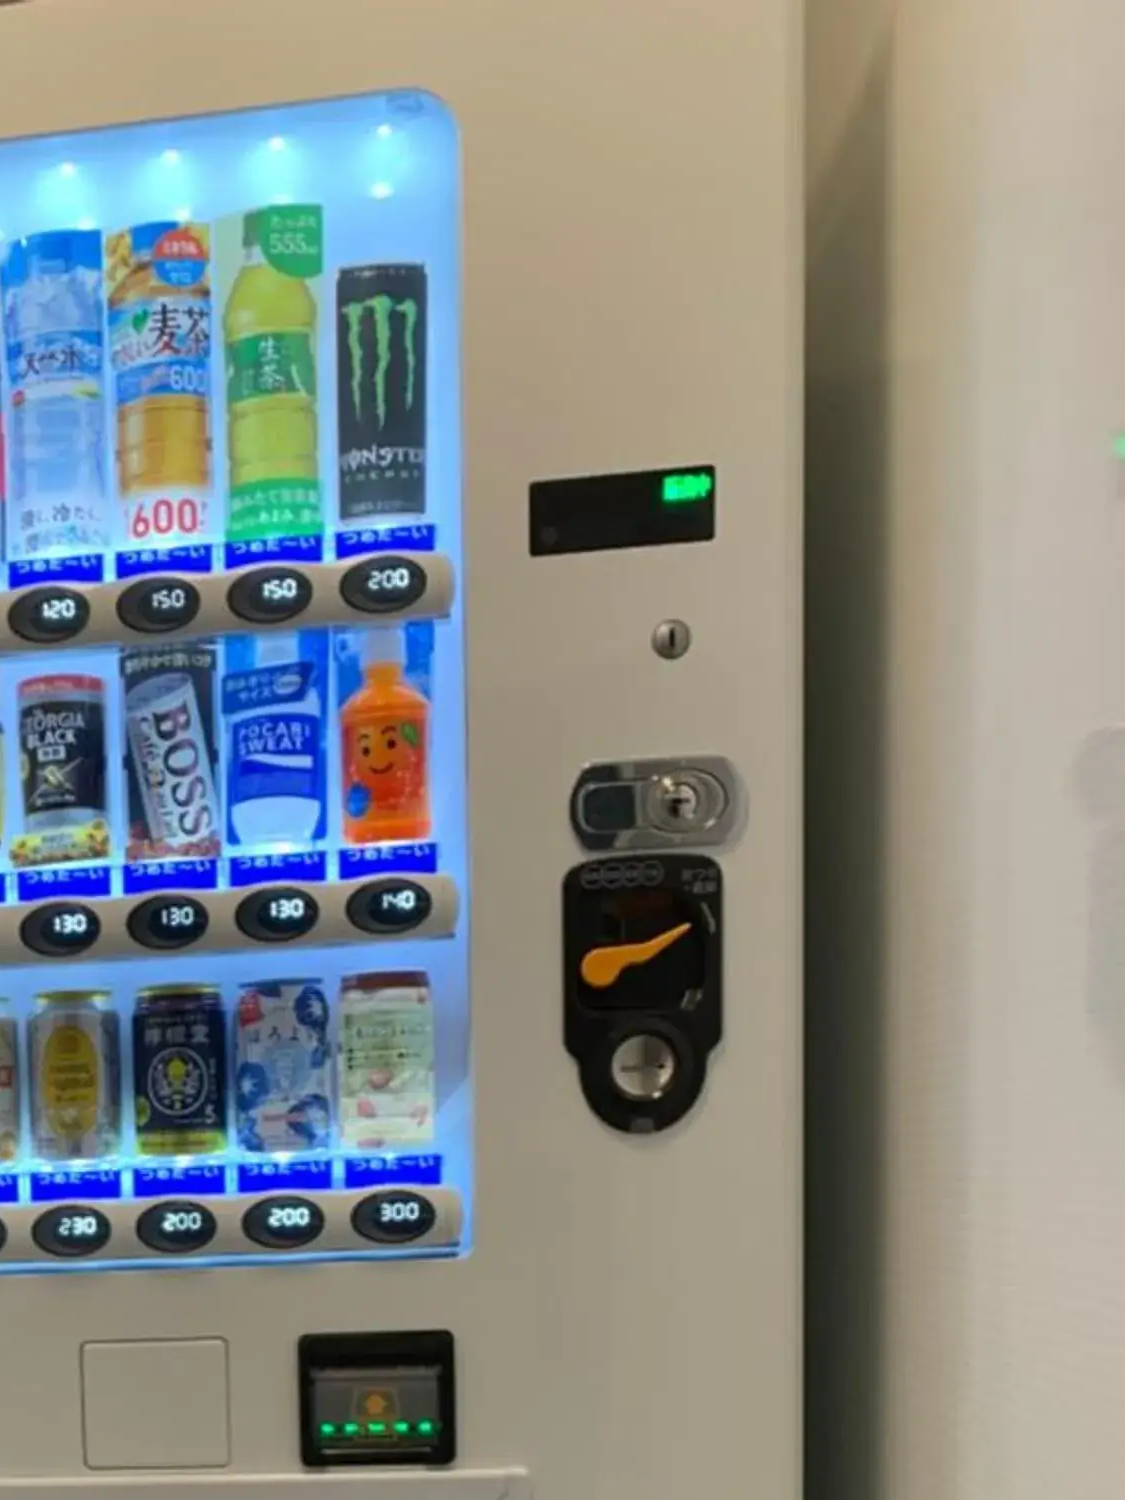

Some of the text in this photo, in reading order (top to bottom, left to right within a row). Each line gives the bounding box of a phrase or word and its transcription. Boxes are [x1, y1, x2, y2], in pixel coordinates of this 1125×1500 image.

[149, 302, 211, 357] 麦茶
[132, 498, 198, 539] 600
[262, 578, 298, 598] 150
[368, 568, 410, 589] 200
[42, 599, 77, 618] 120
[152, 589, 186, 608] 150
[26, 729, 77, 750] BLACK
[239, 721, 311, 741] POCARI
[239, 735, 304, 757] SWEAT
[152, 699, 214, 838] BOSS
[270, 898, 305, 918] 130
[382, 890, 416, 910] 140
[53, 913, 88, 933] 130
[162, 906, 194, 926] 130
[162, 1211, 202, 1232] 200
[268, 1206, 310, 1227] 200
[380, 1202, 419, 1222] 300
[59, 1216, 98, 1237] 230
